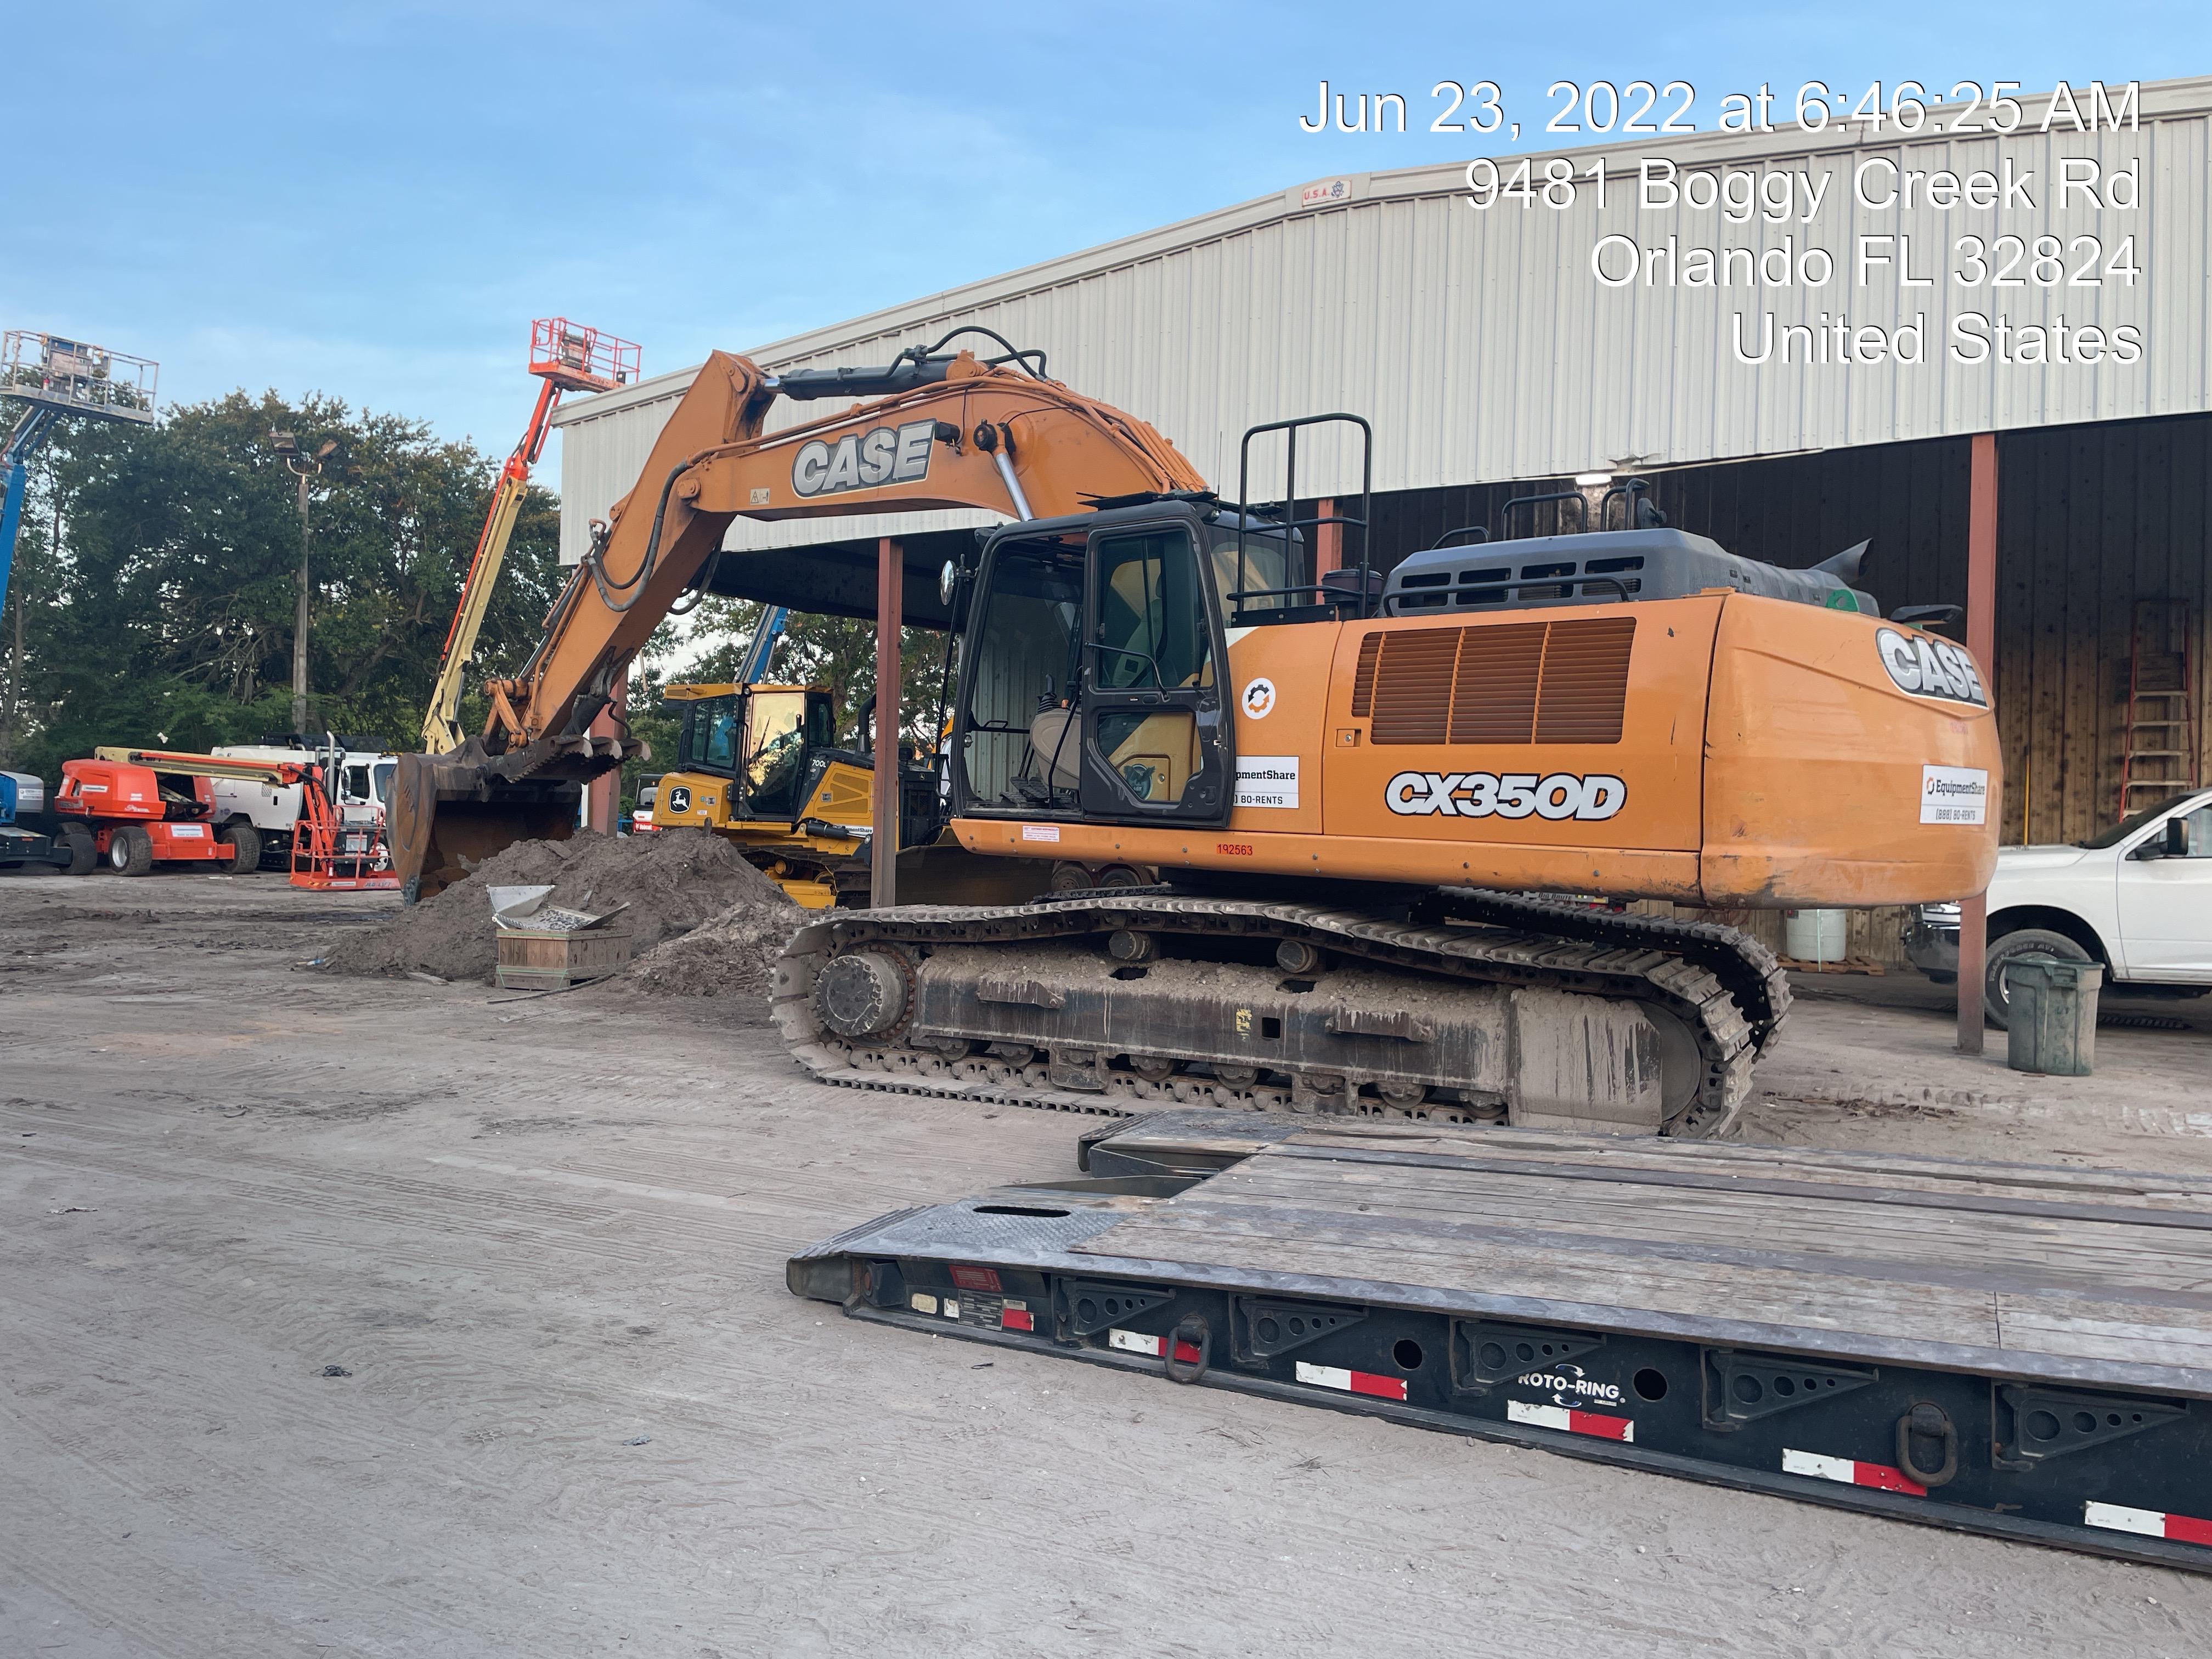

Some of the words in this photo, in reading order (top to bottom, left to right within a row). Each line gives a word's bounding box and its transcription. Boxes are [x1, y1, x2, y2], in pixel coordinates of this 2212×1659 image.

[794, 422, 934, 494] CASE
[1880, 631, 1985, 703] CASE
[1235, 770, 1296, 781] pmentShare
[1385, 771, 1627, 821] CX350D
[1936, 779, 1985, 797] EquipmentShare
[1240, 795, 1283, 804] 80-RENTS
[1936, 808, 1952, 820] (888)
[1953, 810, 1976, 820] 80-RENTS
[1217, 844, 1252, 855] 192563
[1518, 1373, 1619, 1399] ROTO-RING
